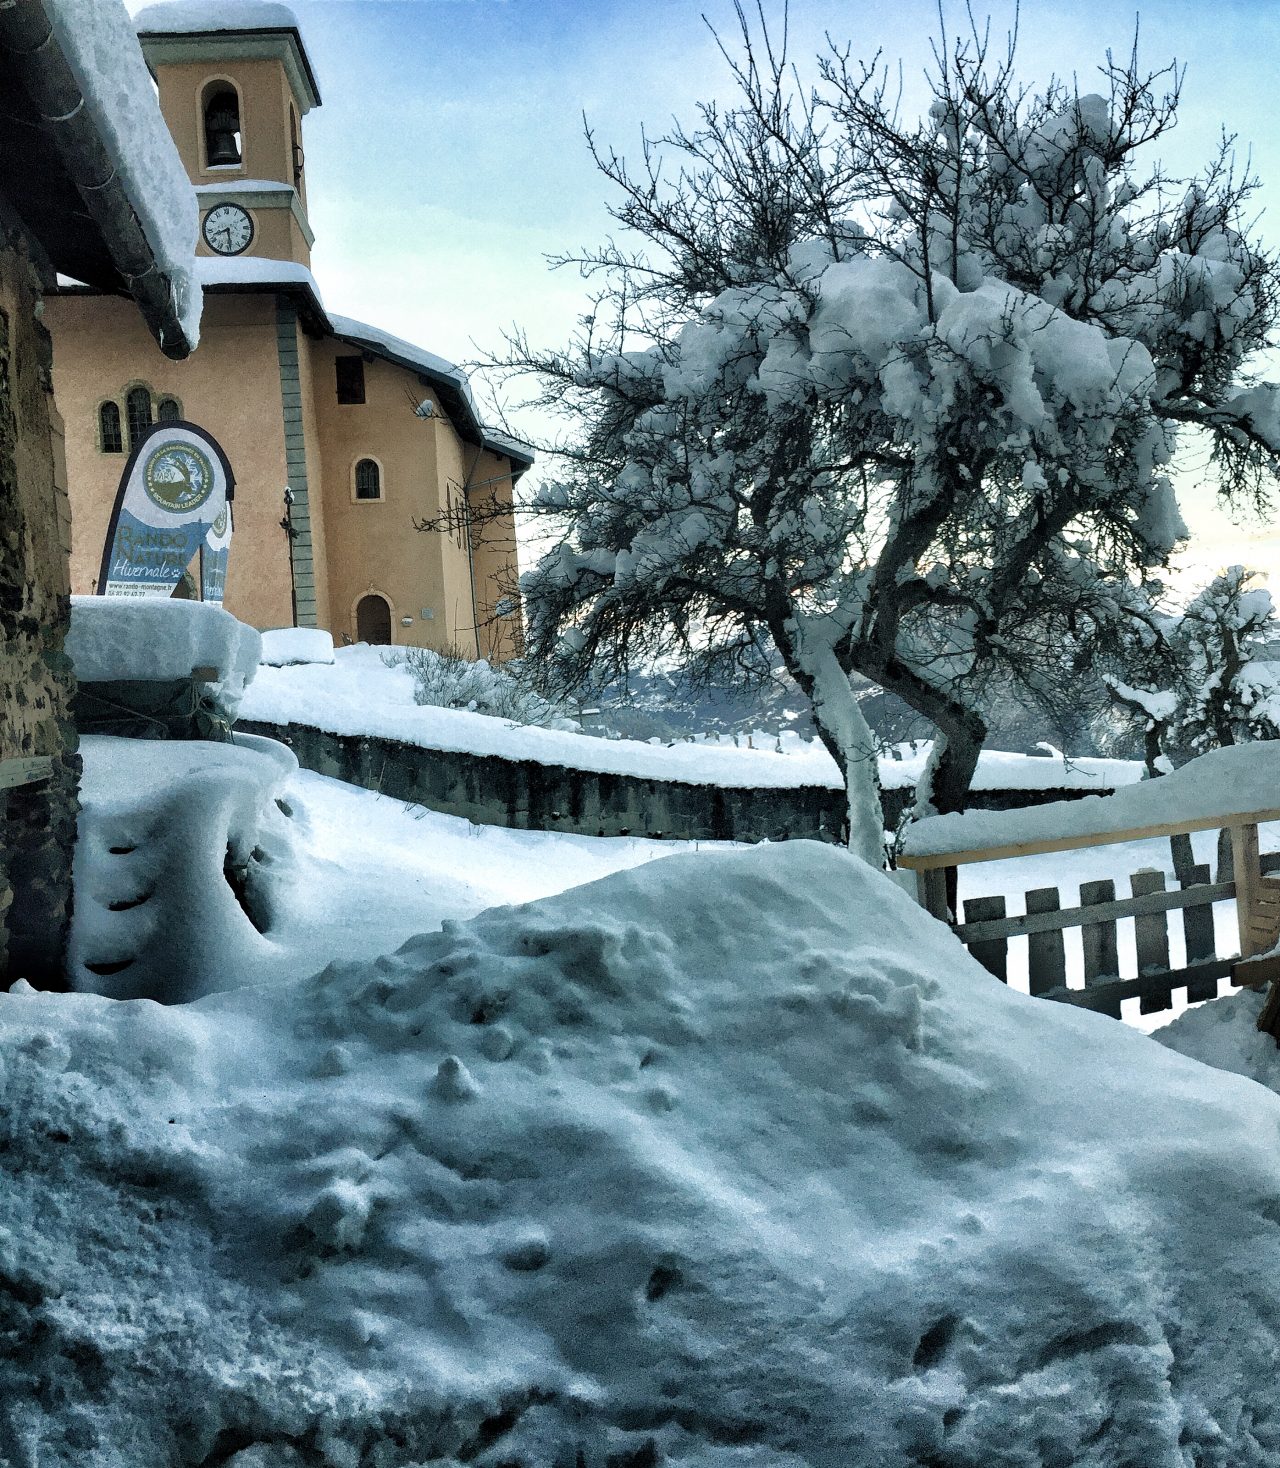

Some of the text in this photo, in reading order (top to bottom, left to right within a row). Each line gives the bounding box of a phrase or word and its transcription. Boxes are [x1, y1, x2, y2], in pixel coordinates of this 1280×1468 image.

[153, 492, 203, 509] MOUNTAIN LEADER
[117, 526, 188, 547] RANDO
[112, 559, 170, 578] Hivernale
